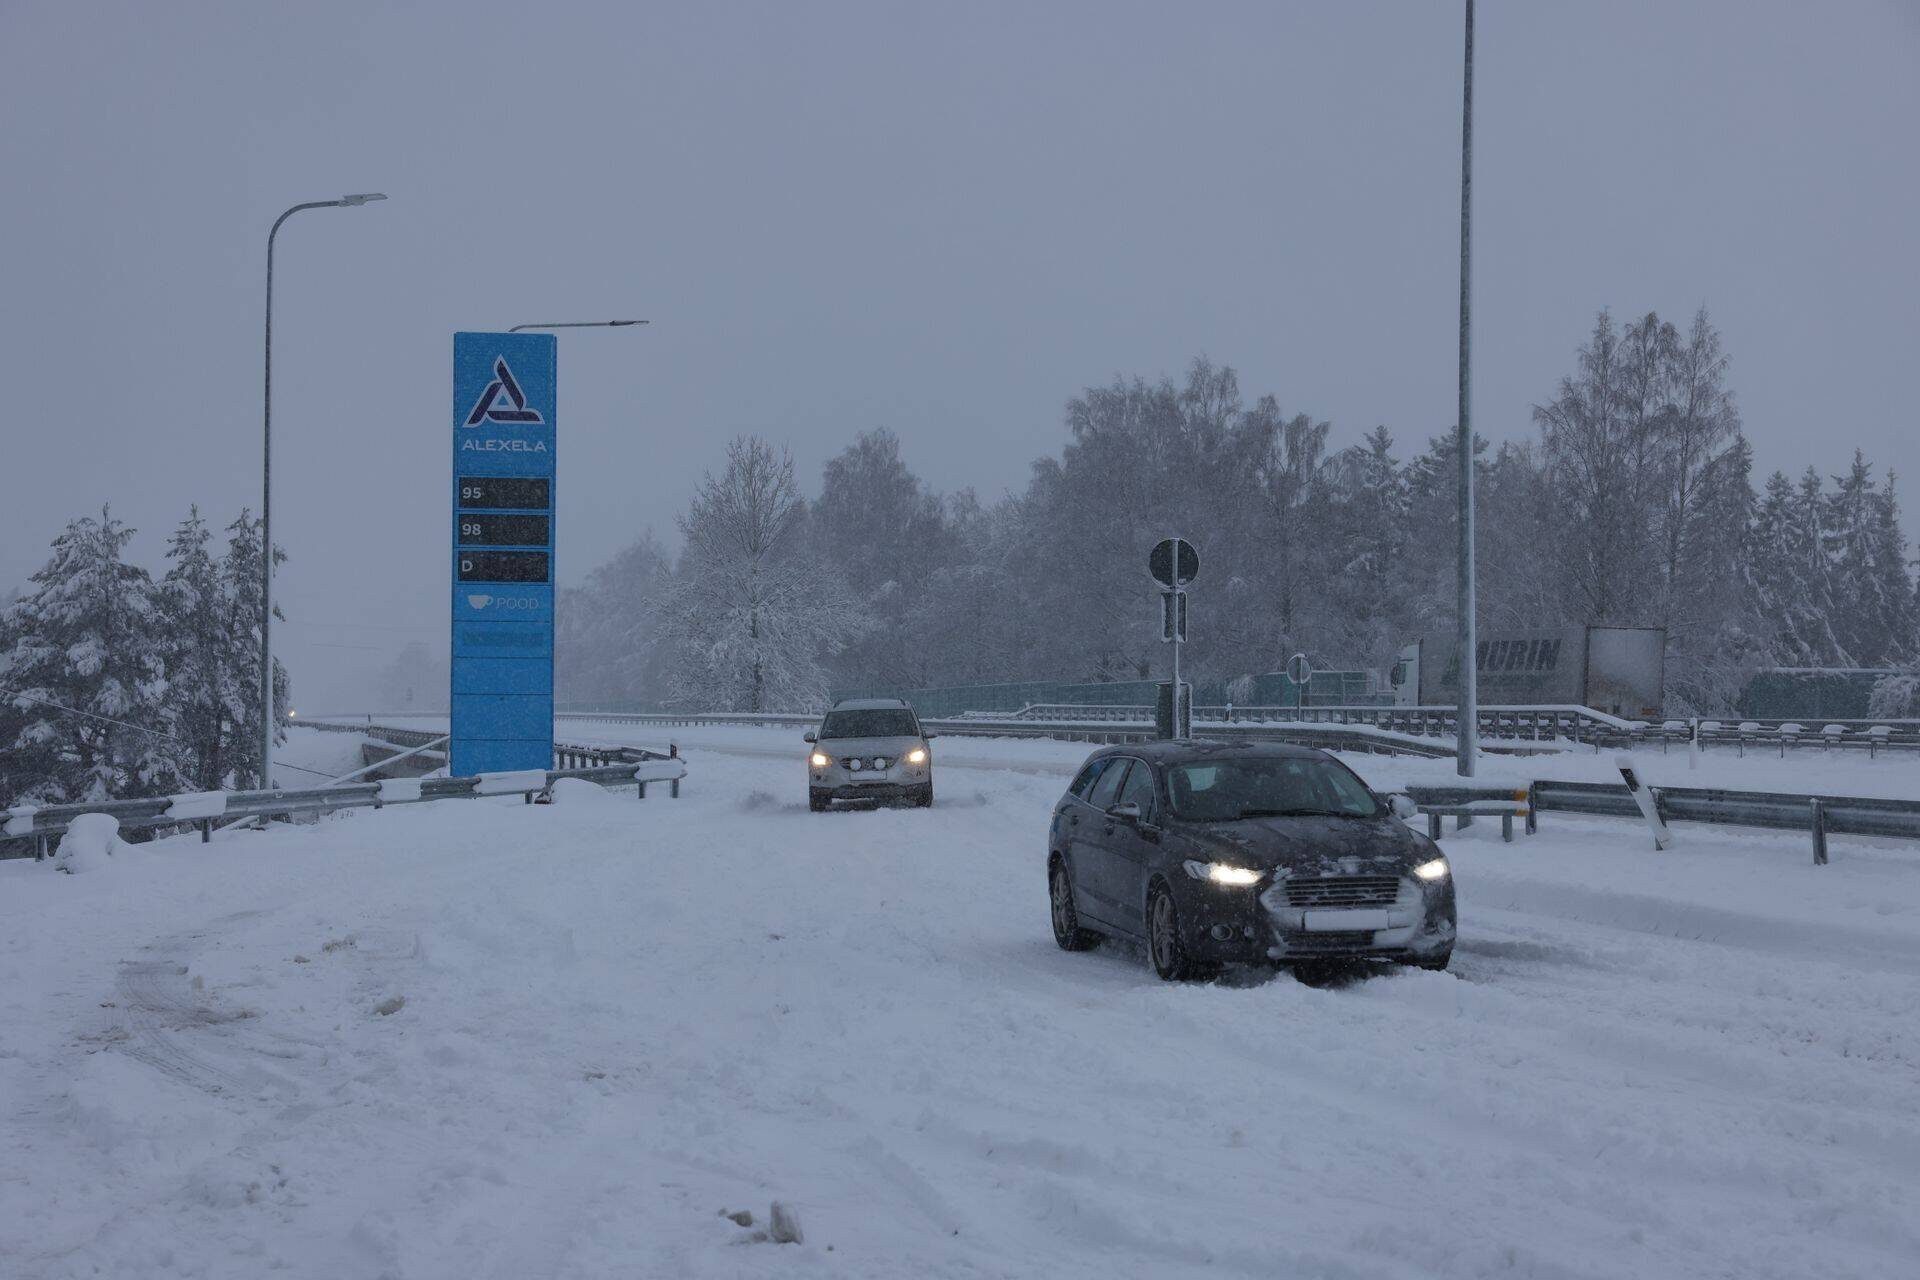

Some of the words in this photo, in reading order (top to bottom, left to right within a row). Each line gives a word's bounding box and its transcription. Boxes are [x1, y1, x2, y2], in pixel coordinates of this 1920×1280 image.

[461, 439, 547, 453] ALEXELA
[462, 487, 482, 499] 95
[462, 523, 482, 536] 98
[461, 559, 474, 572] D
[496, 597, 539, 610] POOD
